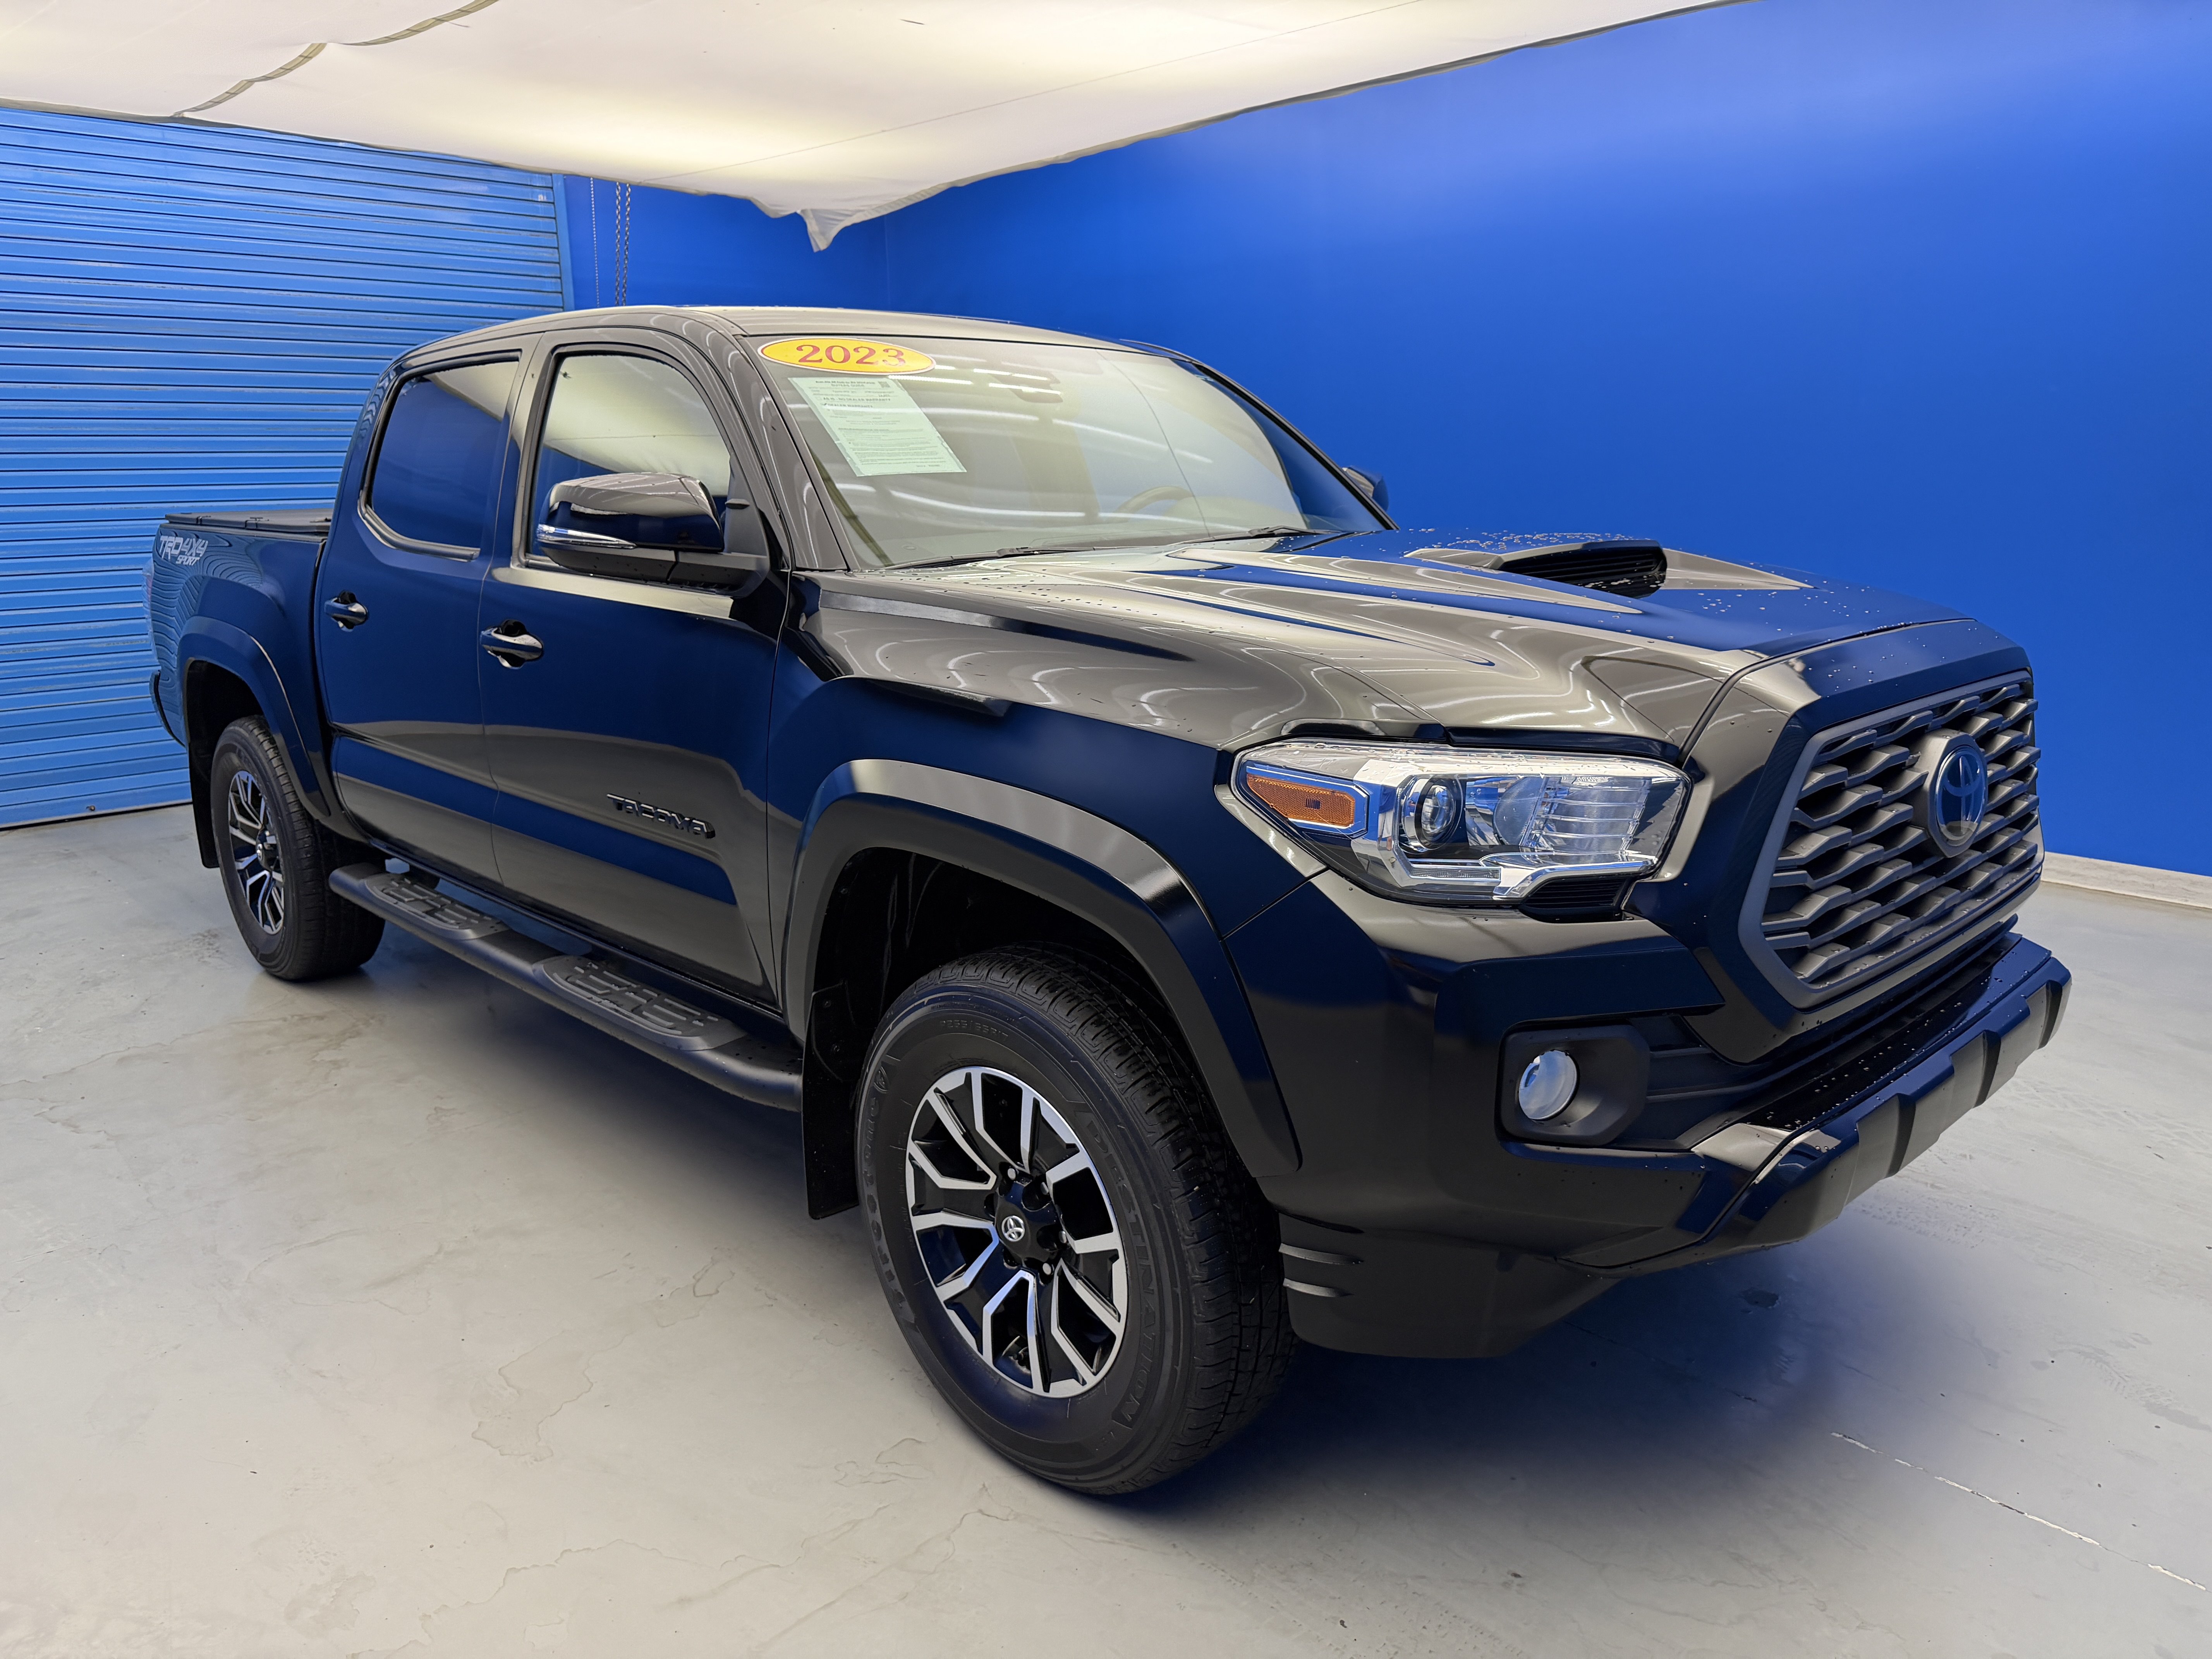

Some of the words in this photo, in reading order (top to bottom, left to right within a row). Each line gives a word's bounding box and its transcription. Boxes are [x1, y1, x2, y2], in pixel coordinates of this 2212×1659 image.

[796, 344, 906, 366] 2023
[159, 535, 184, 560] TRD
[175, 555, 200, 566] SPORT
[607, 793, 716, 839] TACOMA
[1087, 1123, 1156, 1422] DESTINATION
